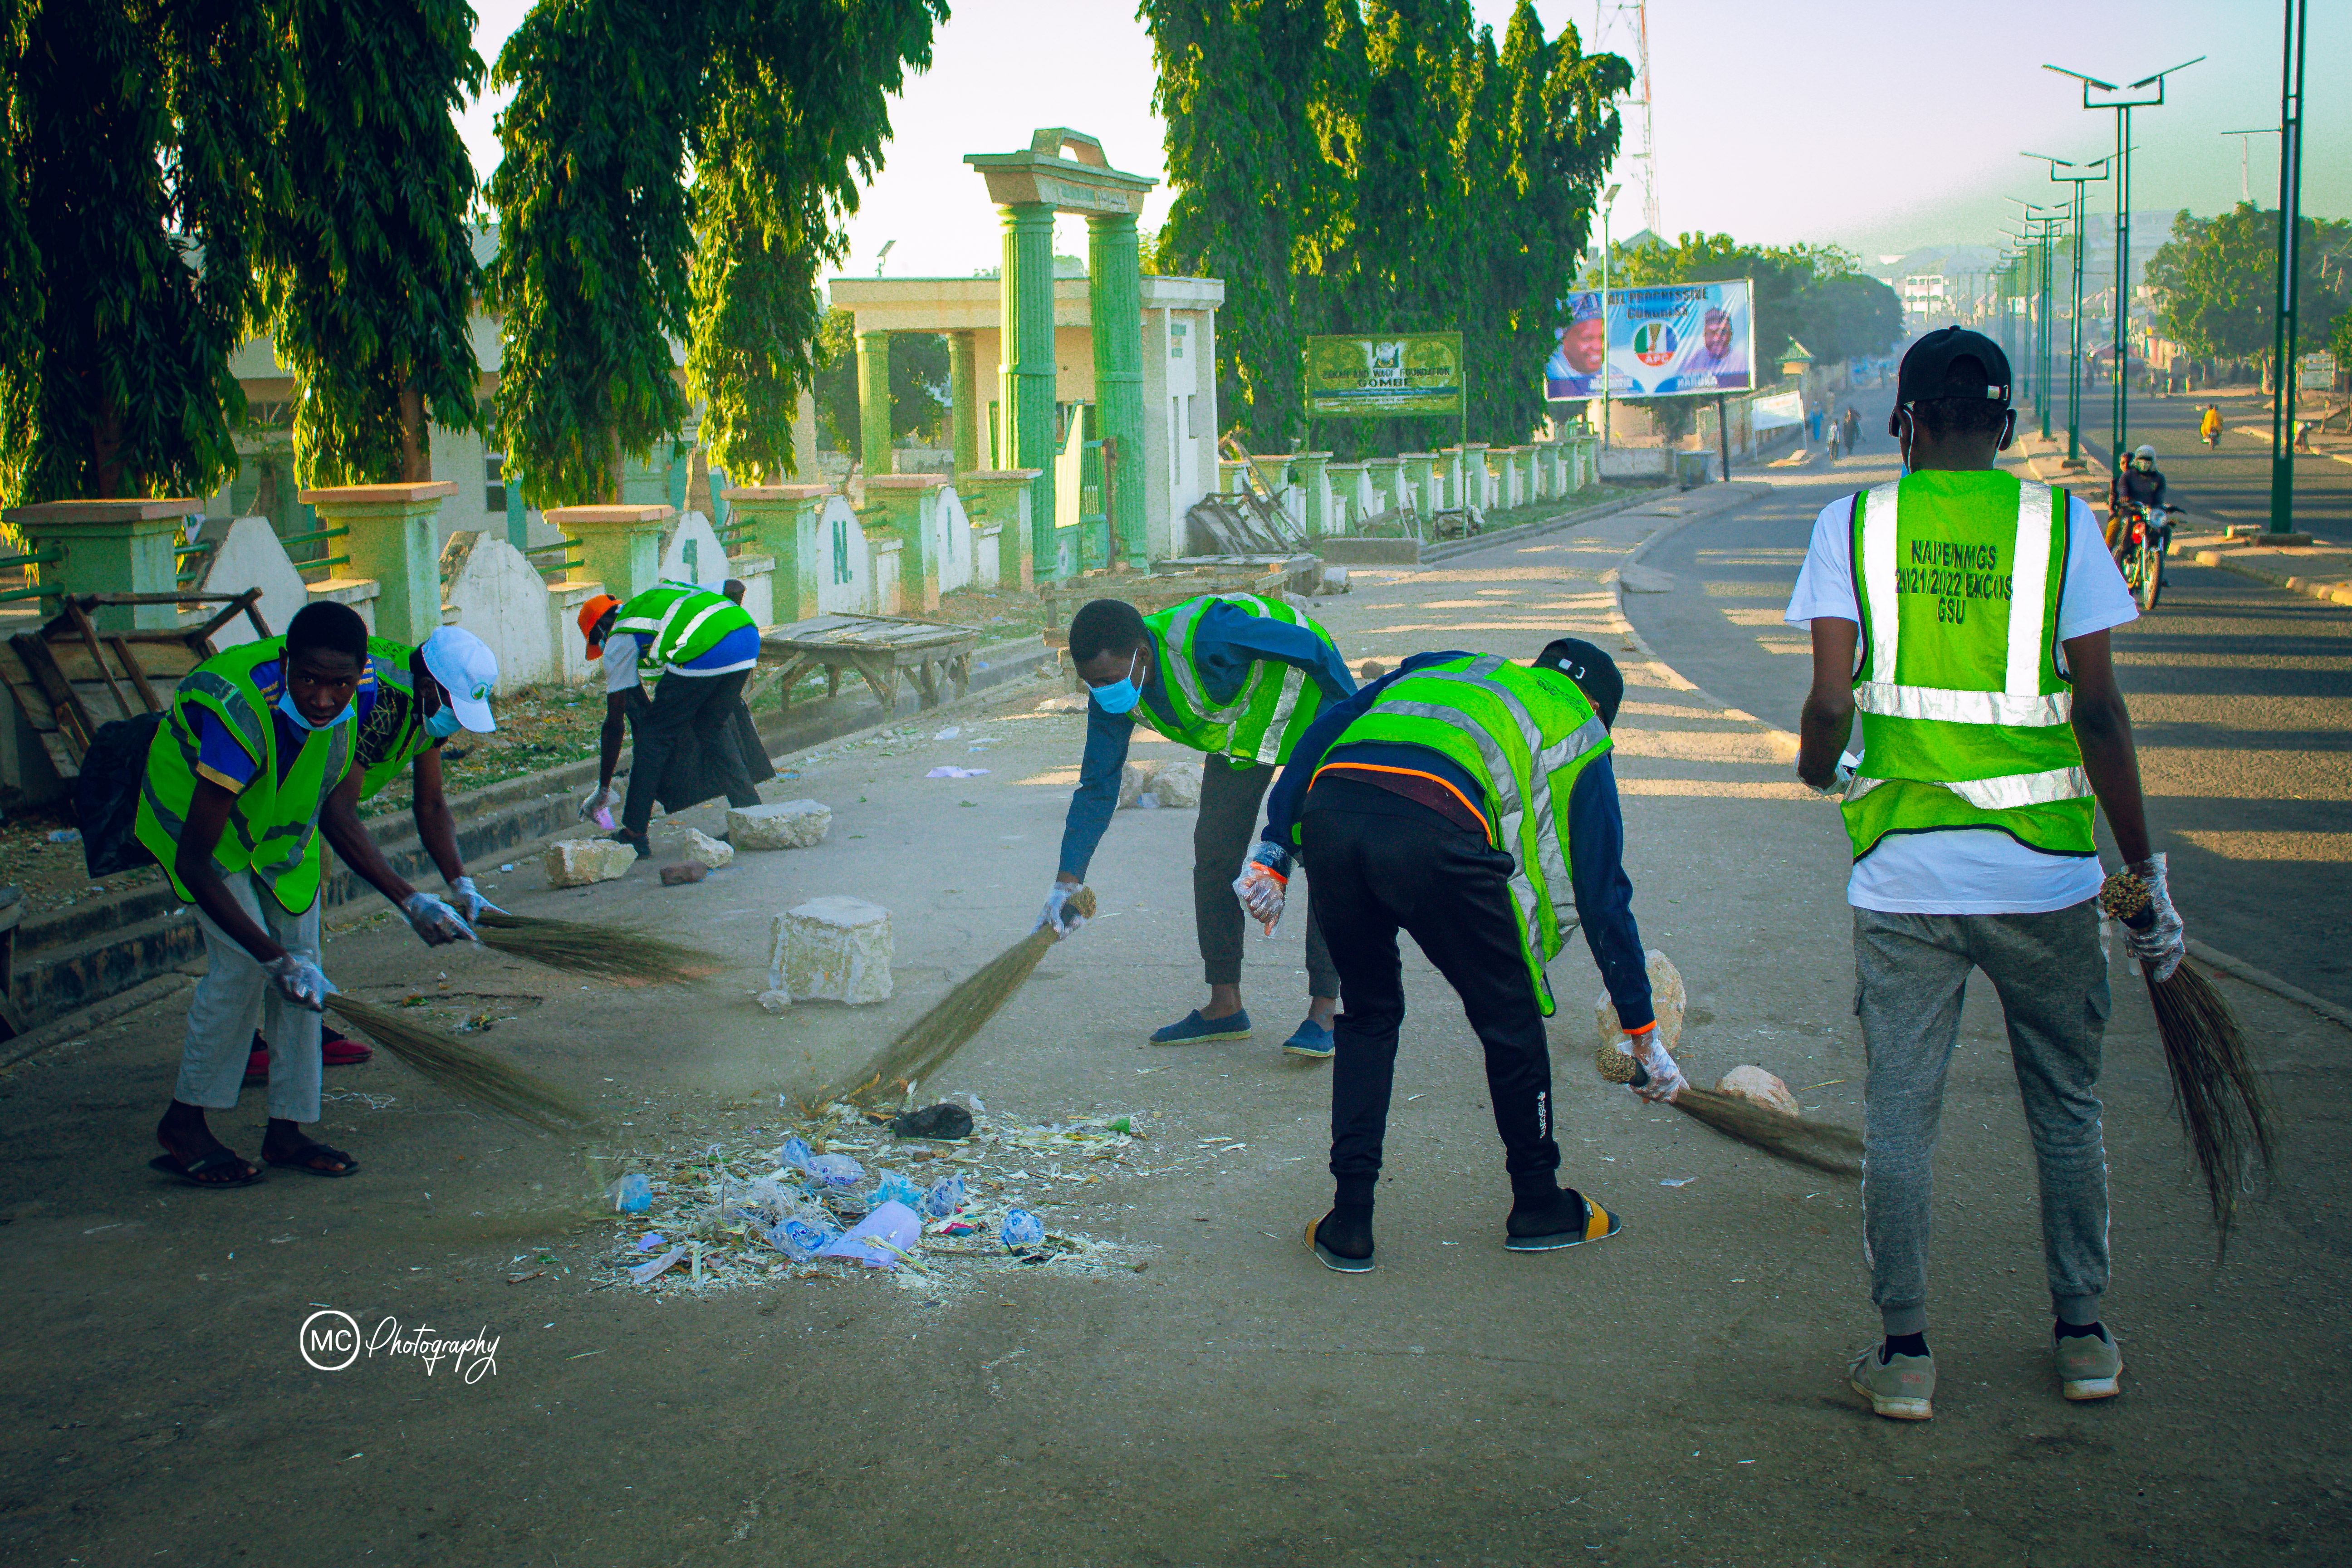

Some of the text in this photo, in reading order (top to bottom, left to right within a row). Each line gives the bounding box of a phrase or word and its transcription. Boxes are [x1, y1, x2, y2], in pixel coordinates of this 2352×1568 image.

[1607, 287, 1708, 305] ALL PROGRESSIVE
[1627, 305, 1688, 319] CONGRESS
[1645, 354, 1668, 363] APC
[1357, 379, 1412, 387] GOMBE
[1911, 540, 1997, 571] NAPE/NMGS
[1895, 567, 2012, 601] 2021/2022 EXCOS
[1937, 597, 1966, 625] GSU
